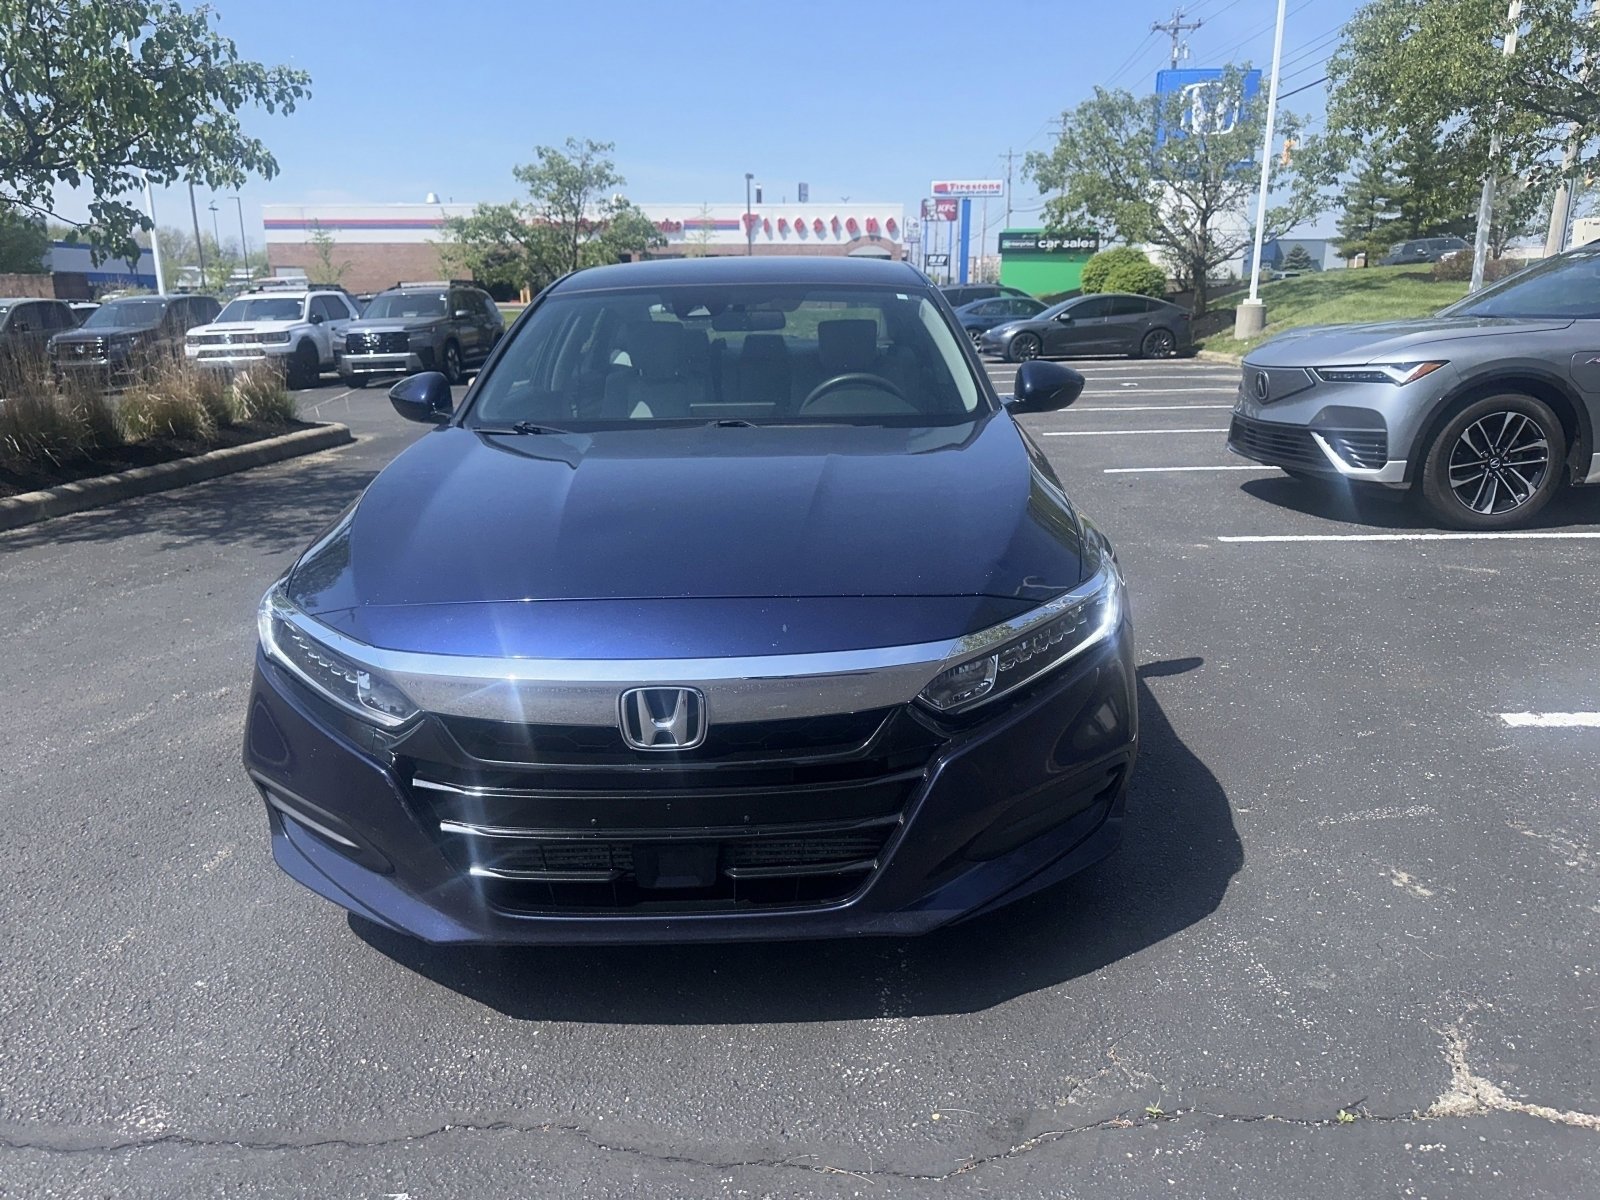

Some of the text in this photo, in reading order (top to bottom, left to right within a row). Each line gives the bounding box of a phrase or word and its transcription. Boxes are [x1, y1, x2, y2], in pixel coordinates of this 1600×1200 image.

[937, 204, 956, 212] KFC
[742, 213, 896, 237] Firestone
[1038, 239, 1060, 249] car
[1062, 238, 1096, 249] sales
